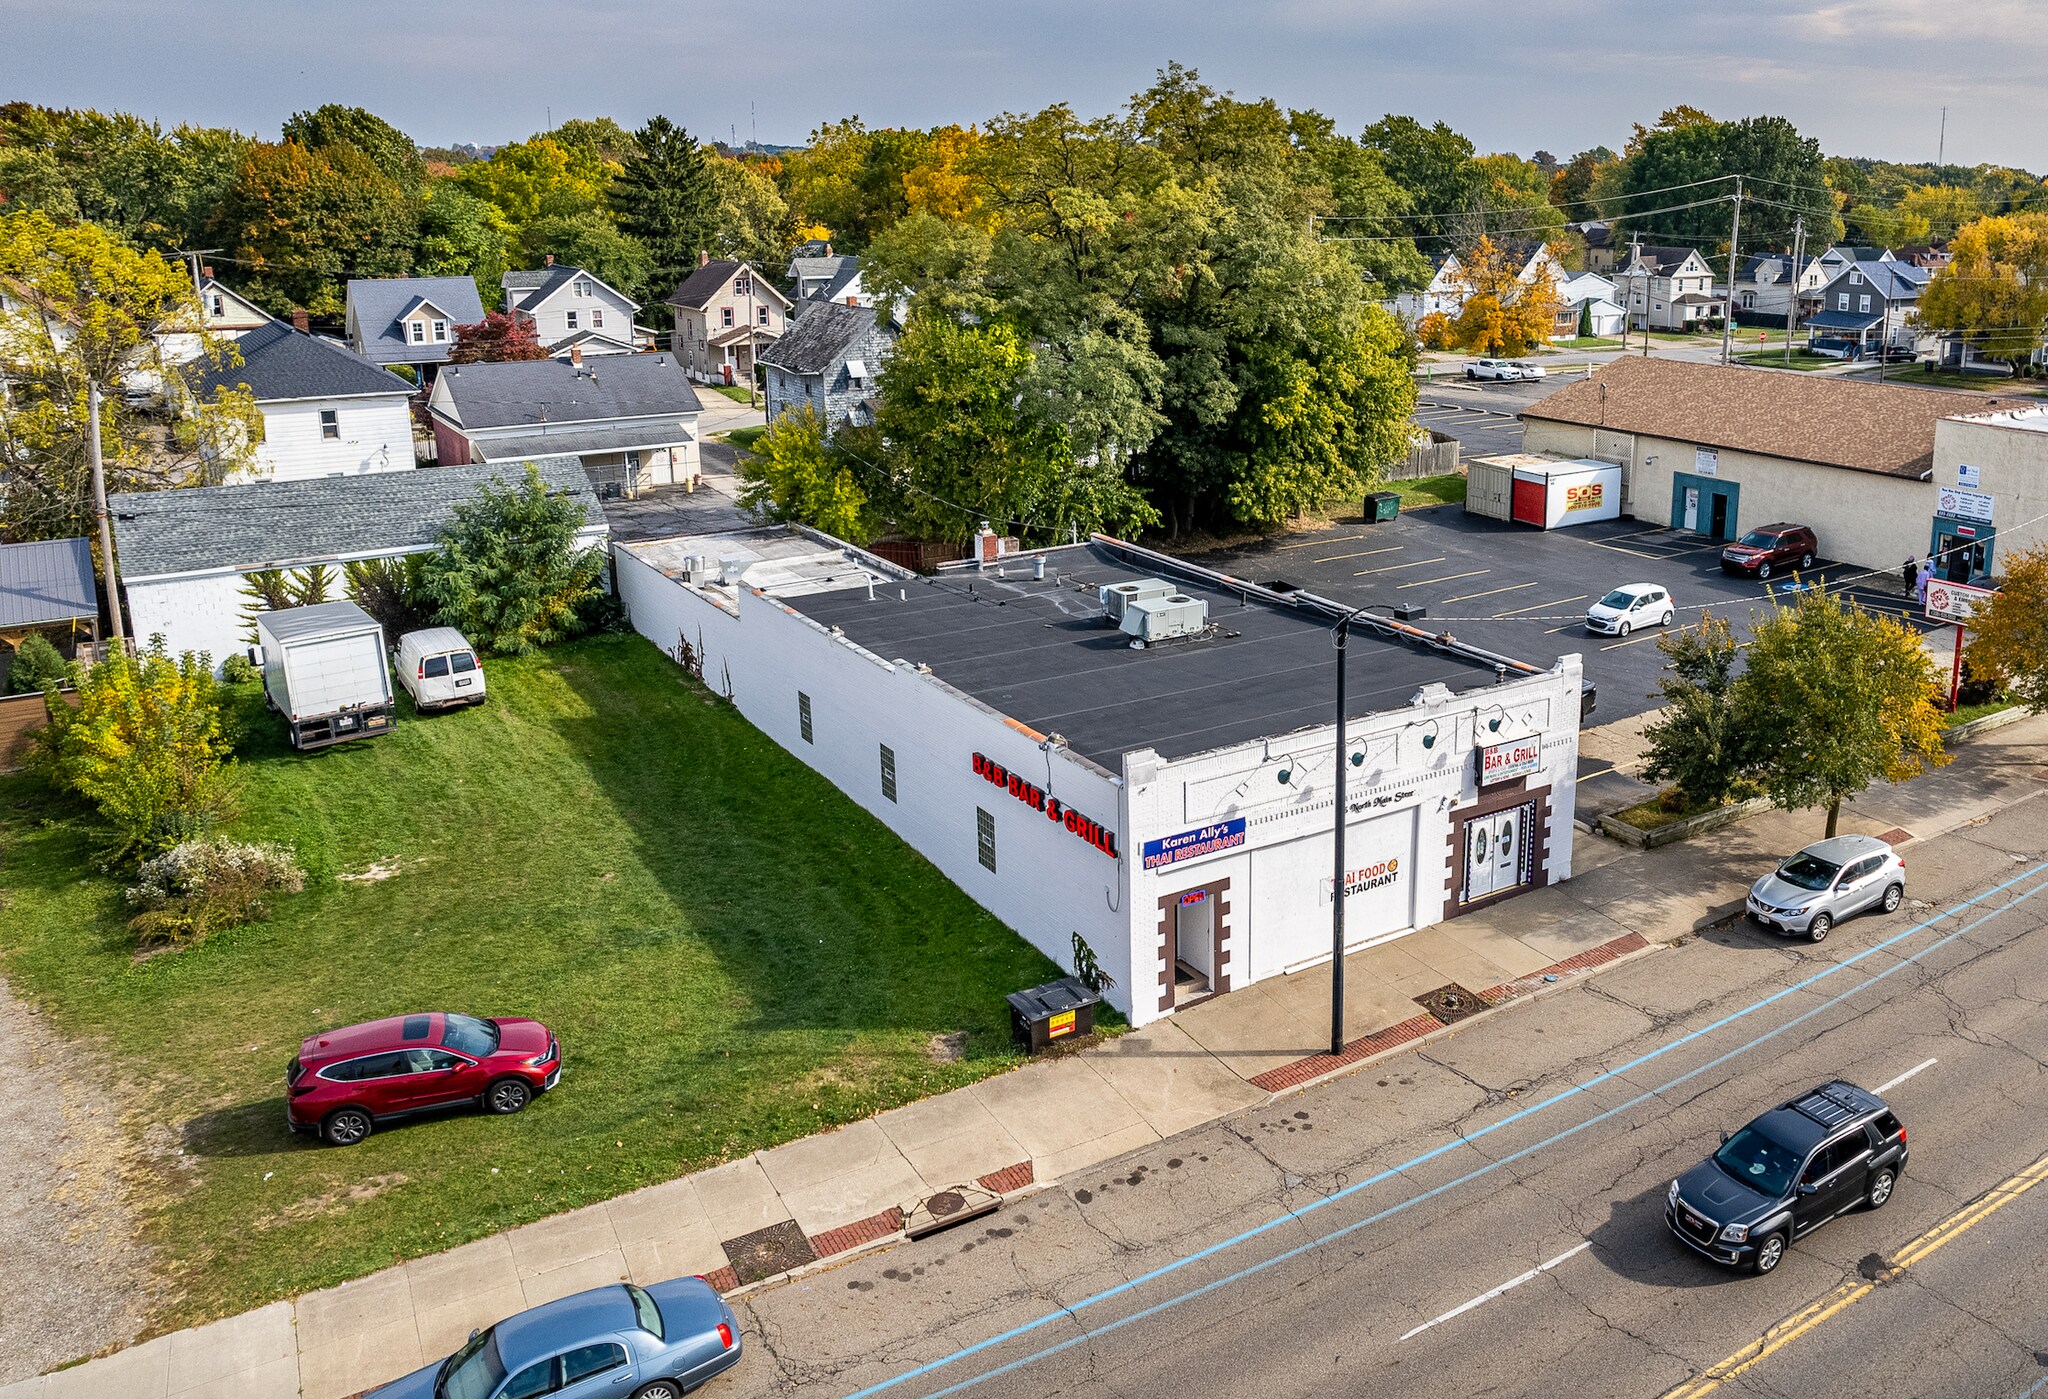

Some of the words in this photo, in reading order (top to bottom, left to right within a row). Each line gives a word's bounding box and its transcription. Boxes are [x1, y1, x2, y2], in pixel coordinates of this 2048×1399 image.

[1485, 755, 1502, 770] BAR
[1505, 753, 1510, 764] &
[1514, 746, 1537, 762] GRILL
[972, 752, 1007, 788] B&B
[1008, 773, 1045, 813] BAR
[1046, 798, 1063, 823] &
[1064, 809, 1119, 859] GRILL
[1162, 834, 1196, 850] Karen
[1199, 824, 1229, 843] Ally's
[1144, 851, 1173, 869] THAI
[1175, 831, 1245, 861] RESTAURANT
[1358, 863, 1386, 881] FOOD
[1684, 1213, 1703, 1230] GMC
